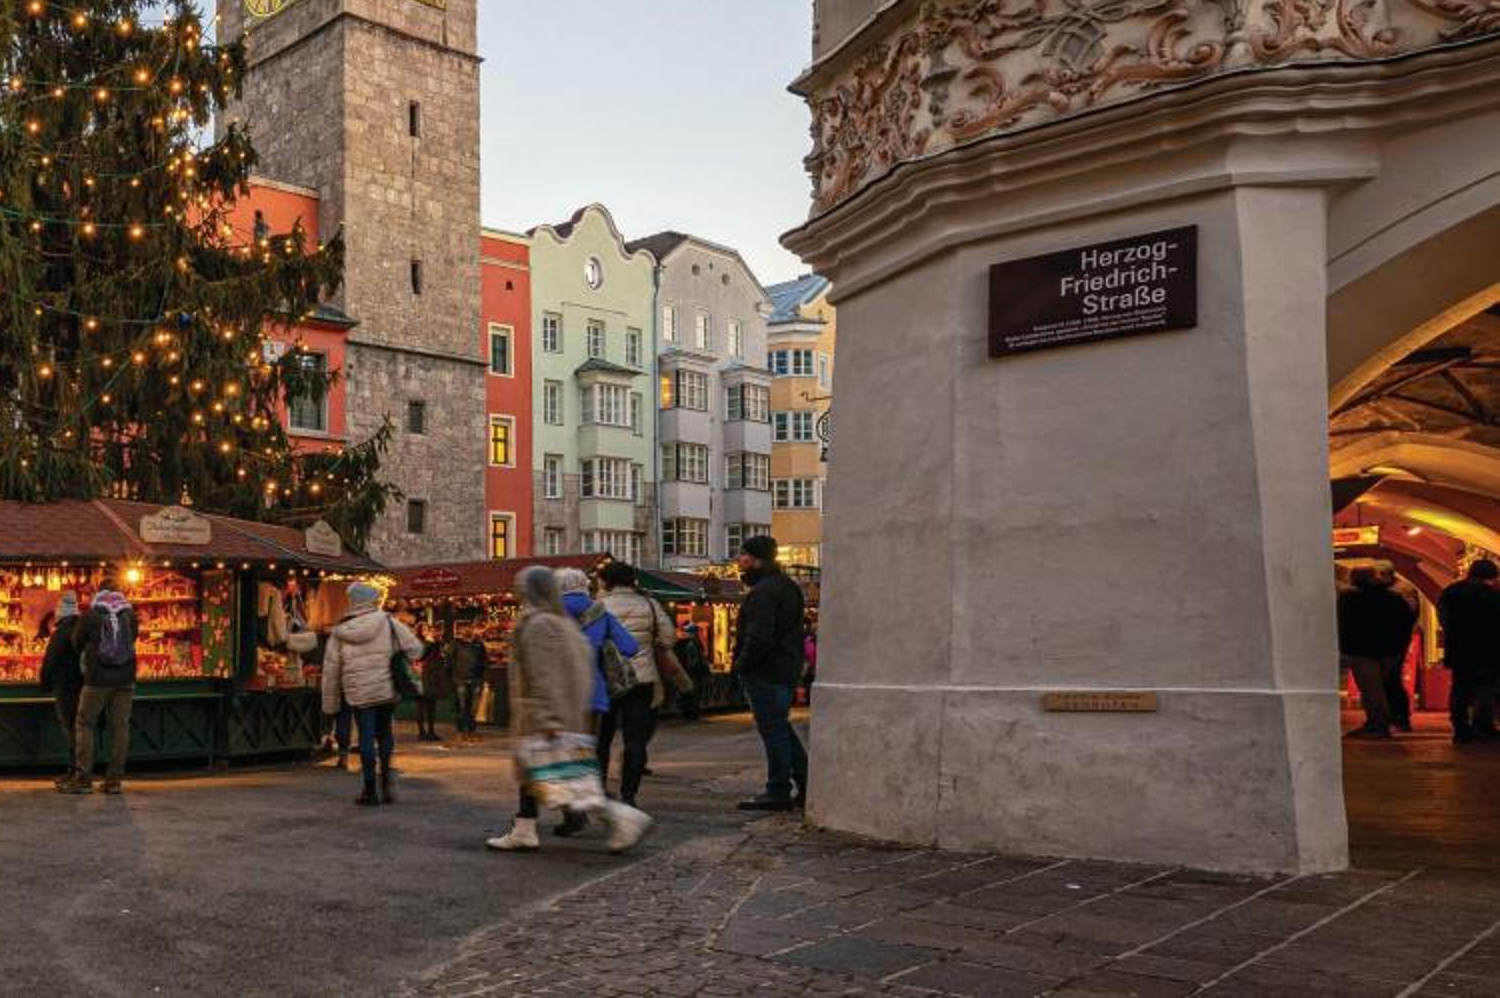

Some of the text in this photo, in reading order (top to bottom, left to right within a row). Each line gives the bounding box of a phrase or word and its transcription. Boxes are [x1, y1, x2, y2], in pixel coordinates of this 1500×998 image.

[1080, 241, 1179, 270] Herzog-
[1060, 262, 1179, 296] Friedrich-
[1082, 285, 1167, 314] Straße
